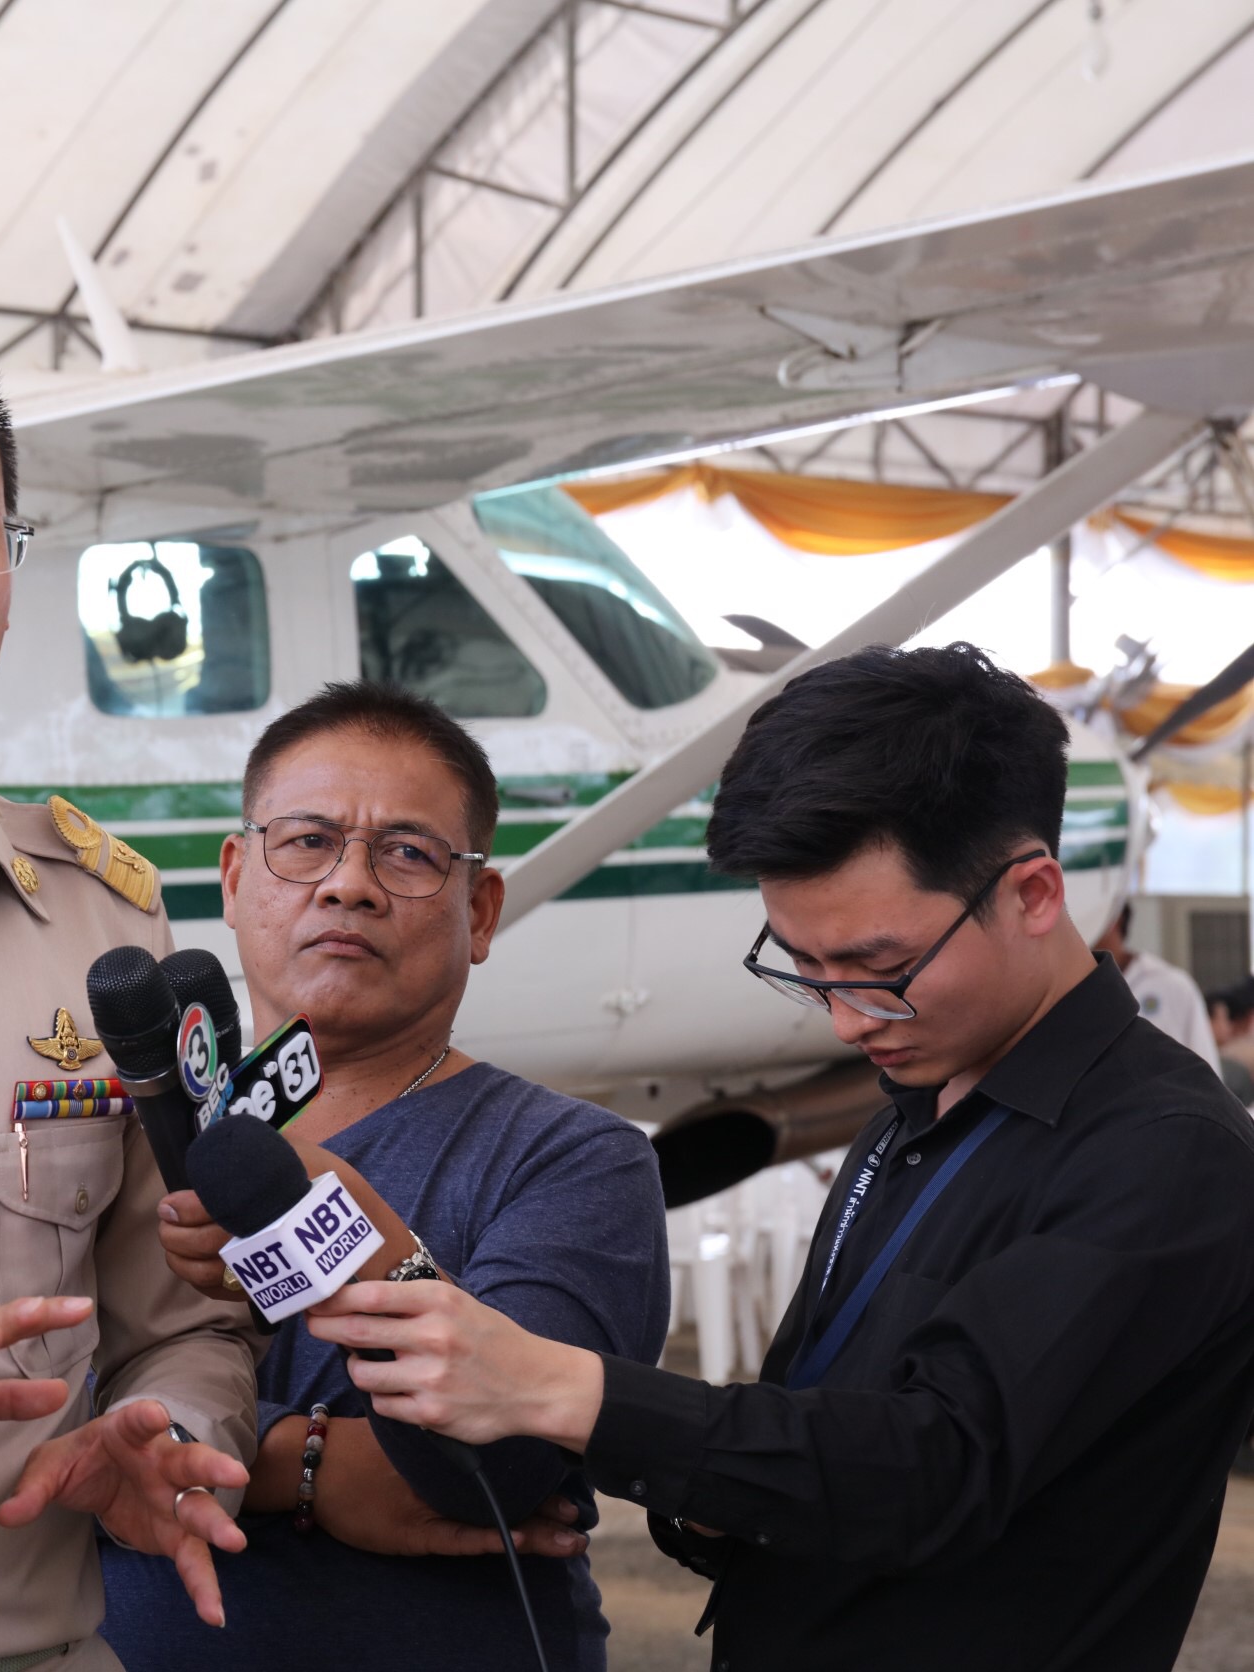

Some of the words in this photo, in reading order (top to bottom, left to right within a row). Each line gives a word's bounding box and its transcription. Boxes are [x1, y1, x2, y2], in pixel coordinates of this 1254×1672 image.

[286, 1039, 316, 1094] 31
[197, 1063, 229, 1132] BEC
[853, 1168, 875, 1197] NNT
[293, 1186, 352, 1254] NBT
[317, 1218, 370, 1272] WORLD
[232, 1241, 292, 1289] NBT
[255, 1273, 310, 1308] WORLD
